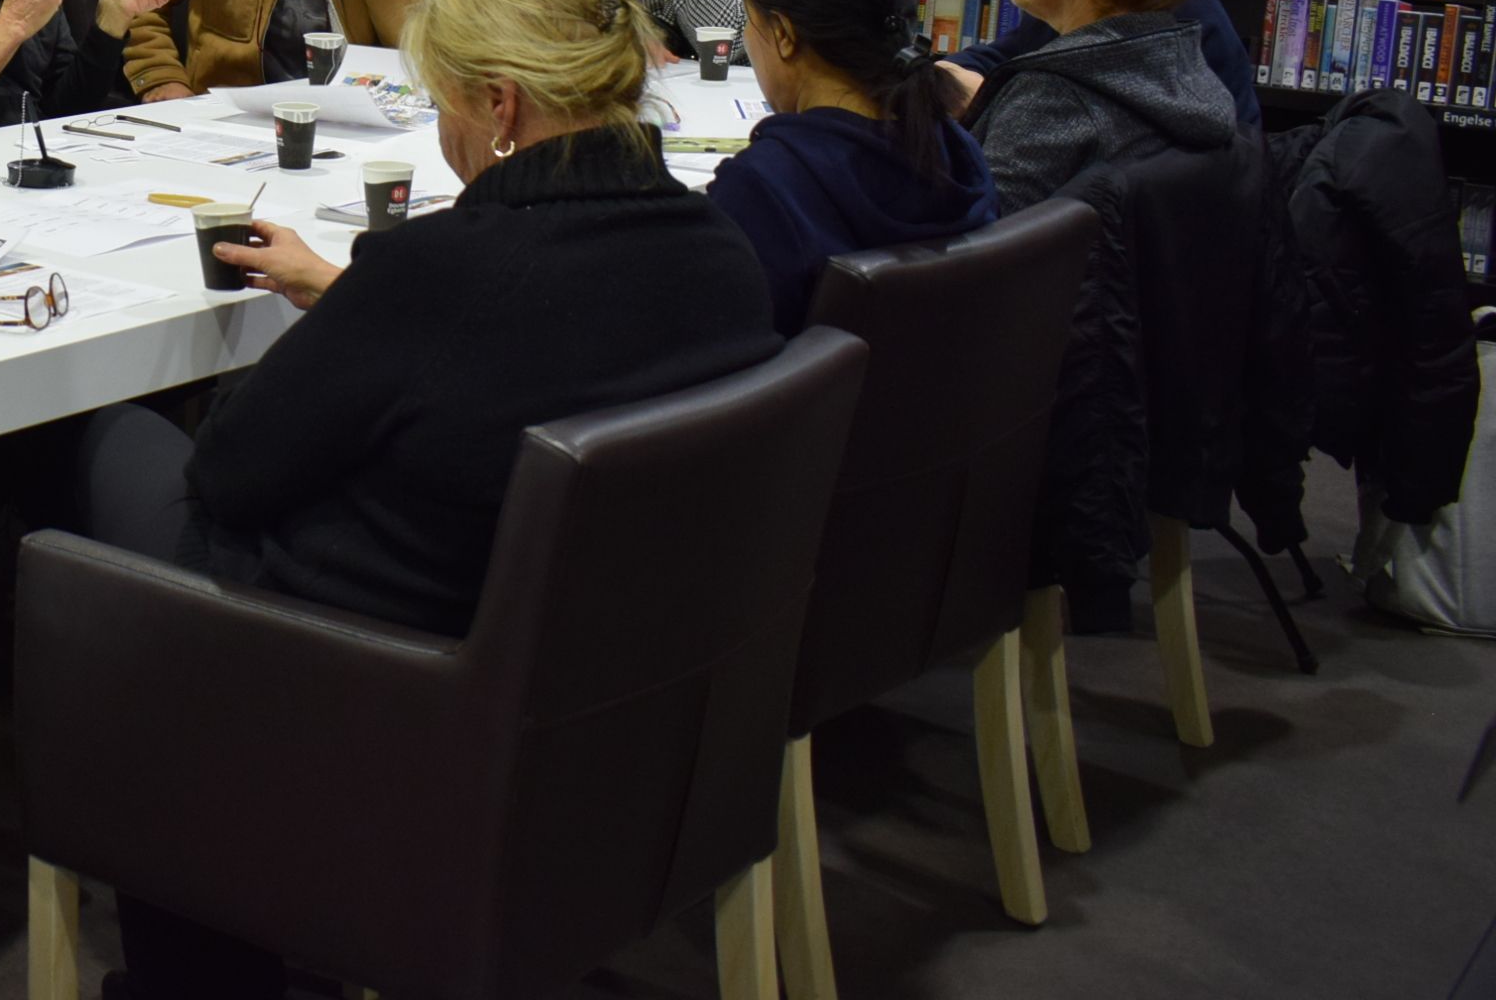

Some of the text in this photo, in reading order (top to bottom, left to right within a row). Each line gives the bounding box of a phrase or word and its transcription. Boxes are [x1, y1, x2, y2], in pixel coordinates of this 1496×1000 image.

[1340, 16, 1353, 51] ARCHER
[1376, 27, 1388, 62] ATWOOD
[1443, 111, 1493, 128] Engelse
